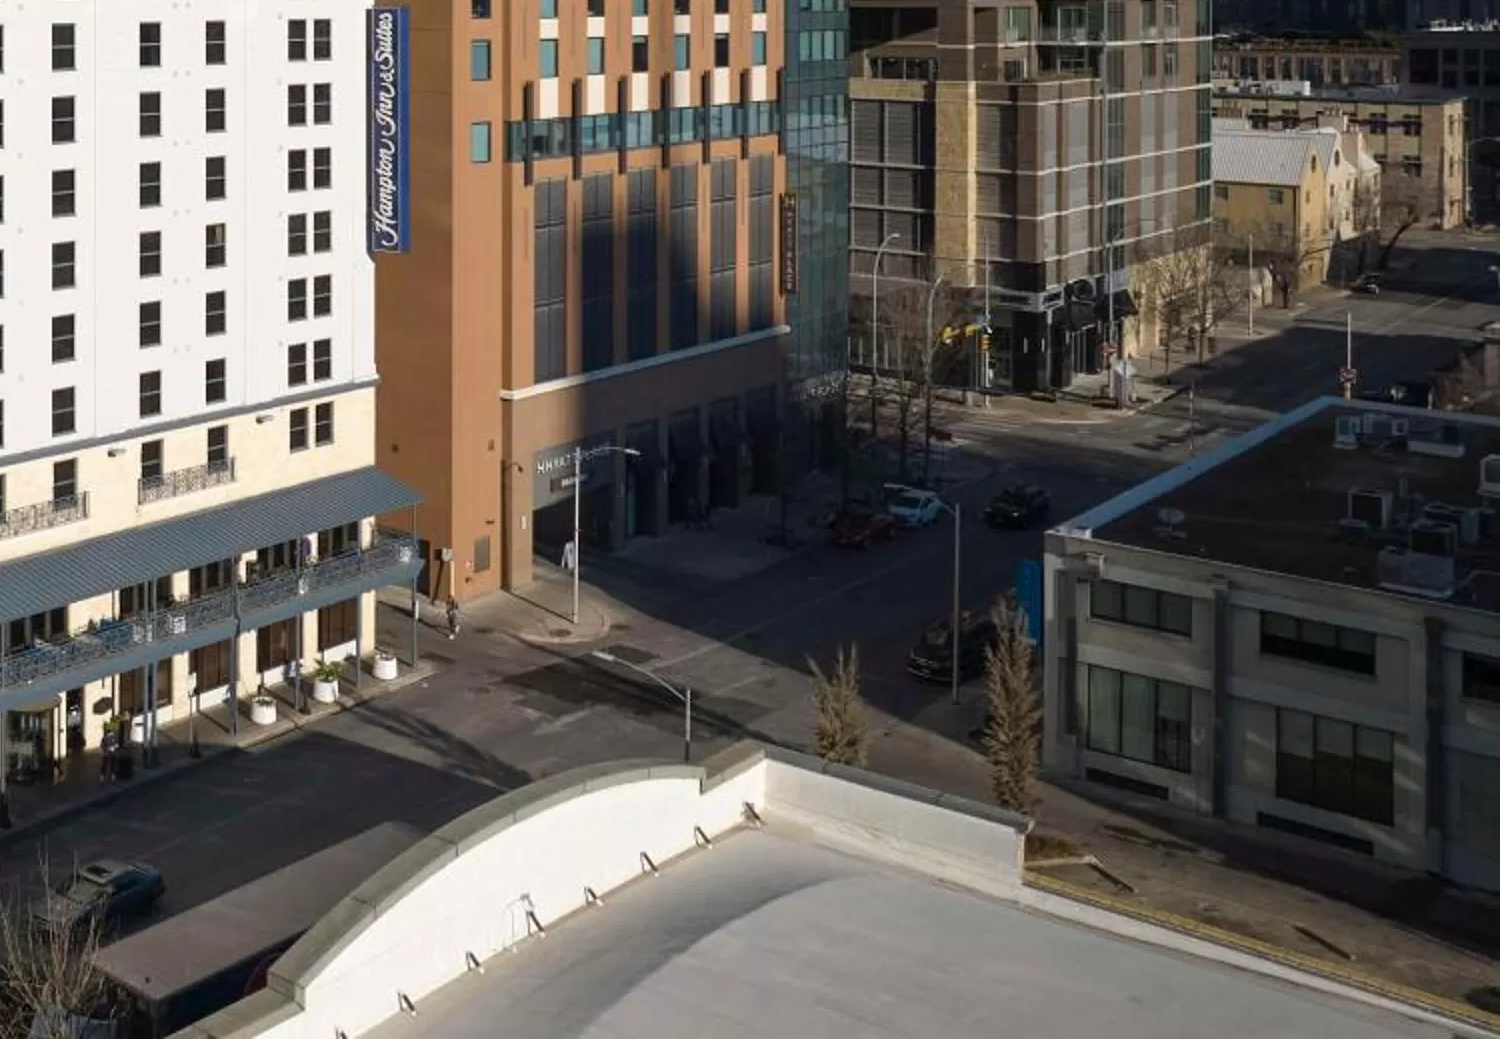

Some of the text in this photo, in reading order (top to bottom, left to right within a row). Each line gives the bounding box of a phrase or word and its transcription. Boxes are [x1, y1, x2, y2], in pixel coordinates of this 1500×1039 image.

[375, 12, 394, 71] Suites
[375, 82, 397, 137] Inn
[373, 138, 398, 246] Hampton
